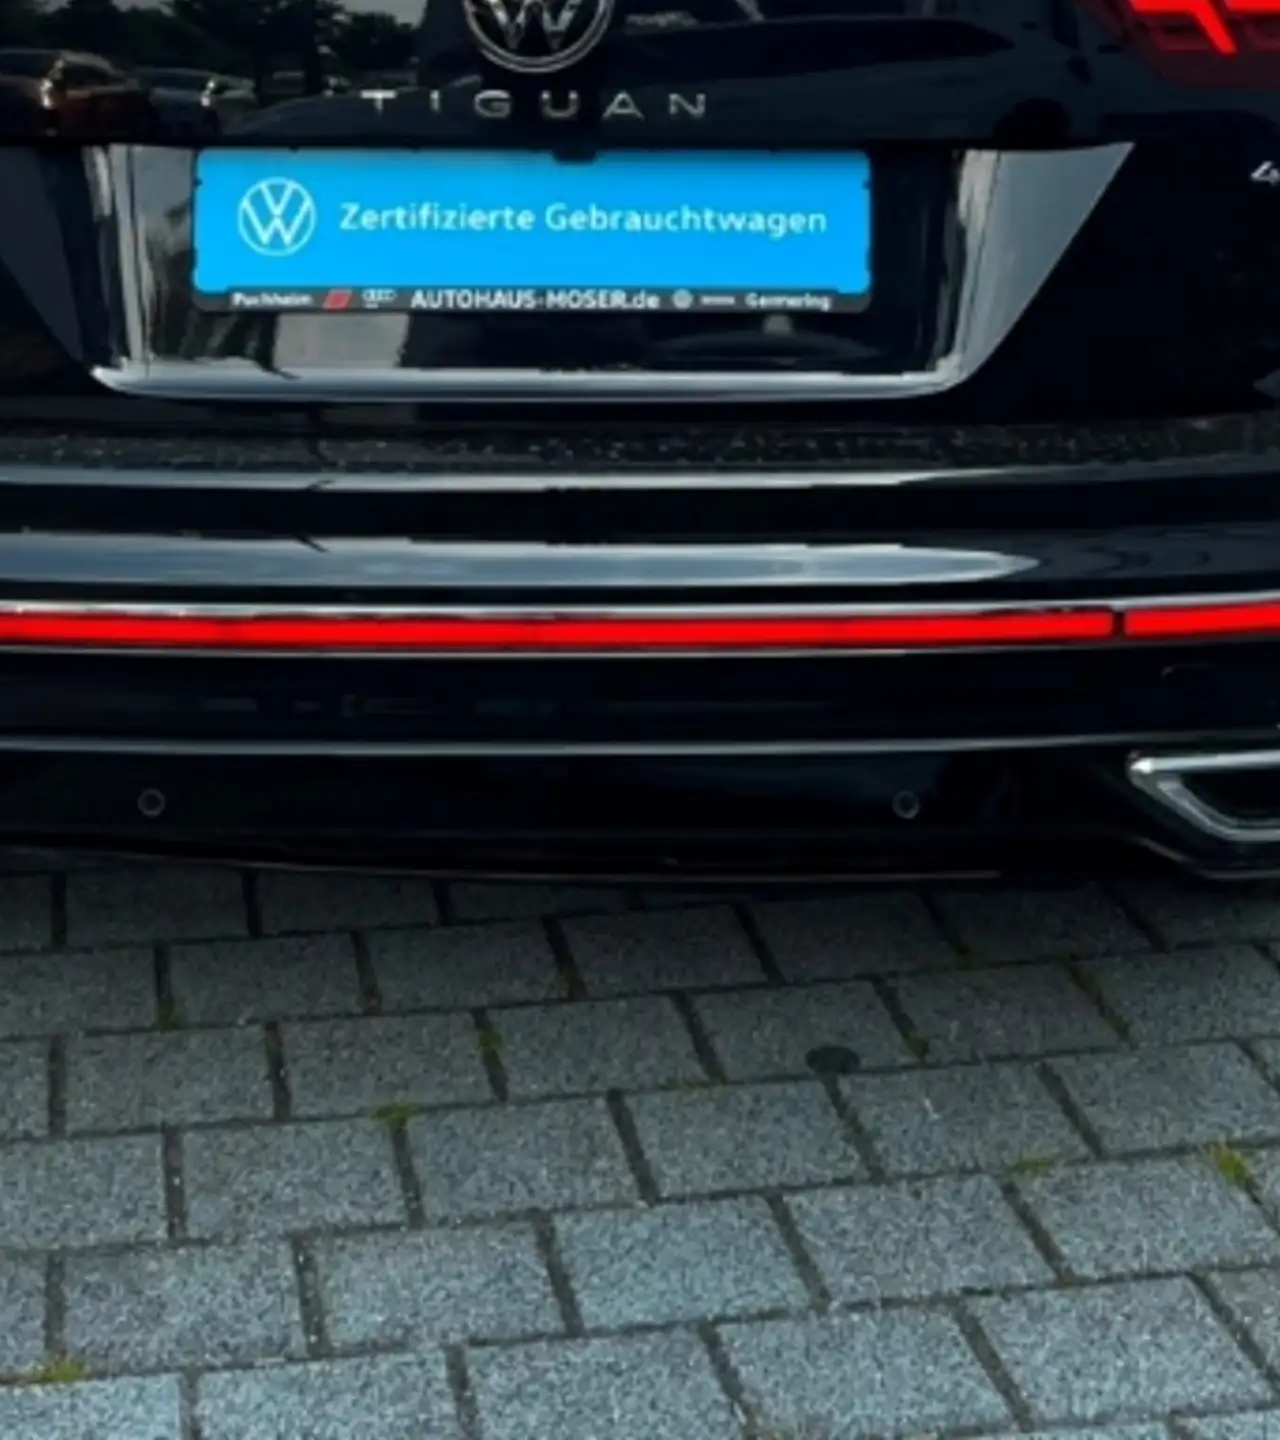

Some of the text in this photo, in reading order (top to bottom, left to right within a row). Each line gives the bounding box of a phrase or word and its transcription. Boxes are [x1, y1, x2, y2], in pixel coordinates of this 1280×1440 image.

[360, 89, 707, 120] TIGUAN
[338, 201, 828, 242] Zertifizierte Gebrauchtwagen
